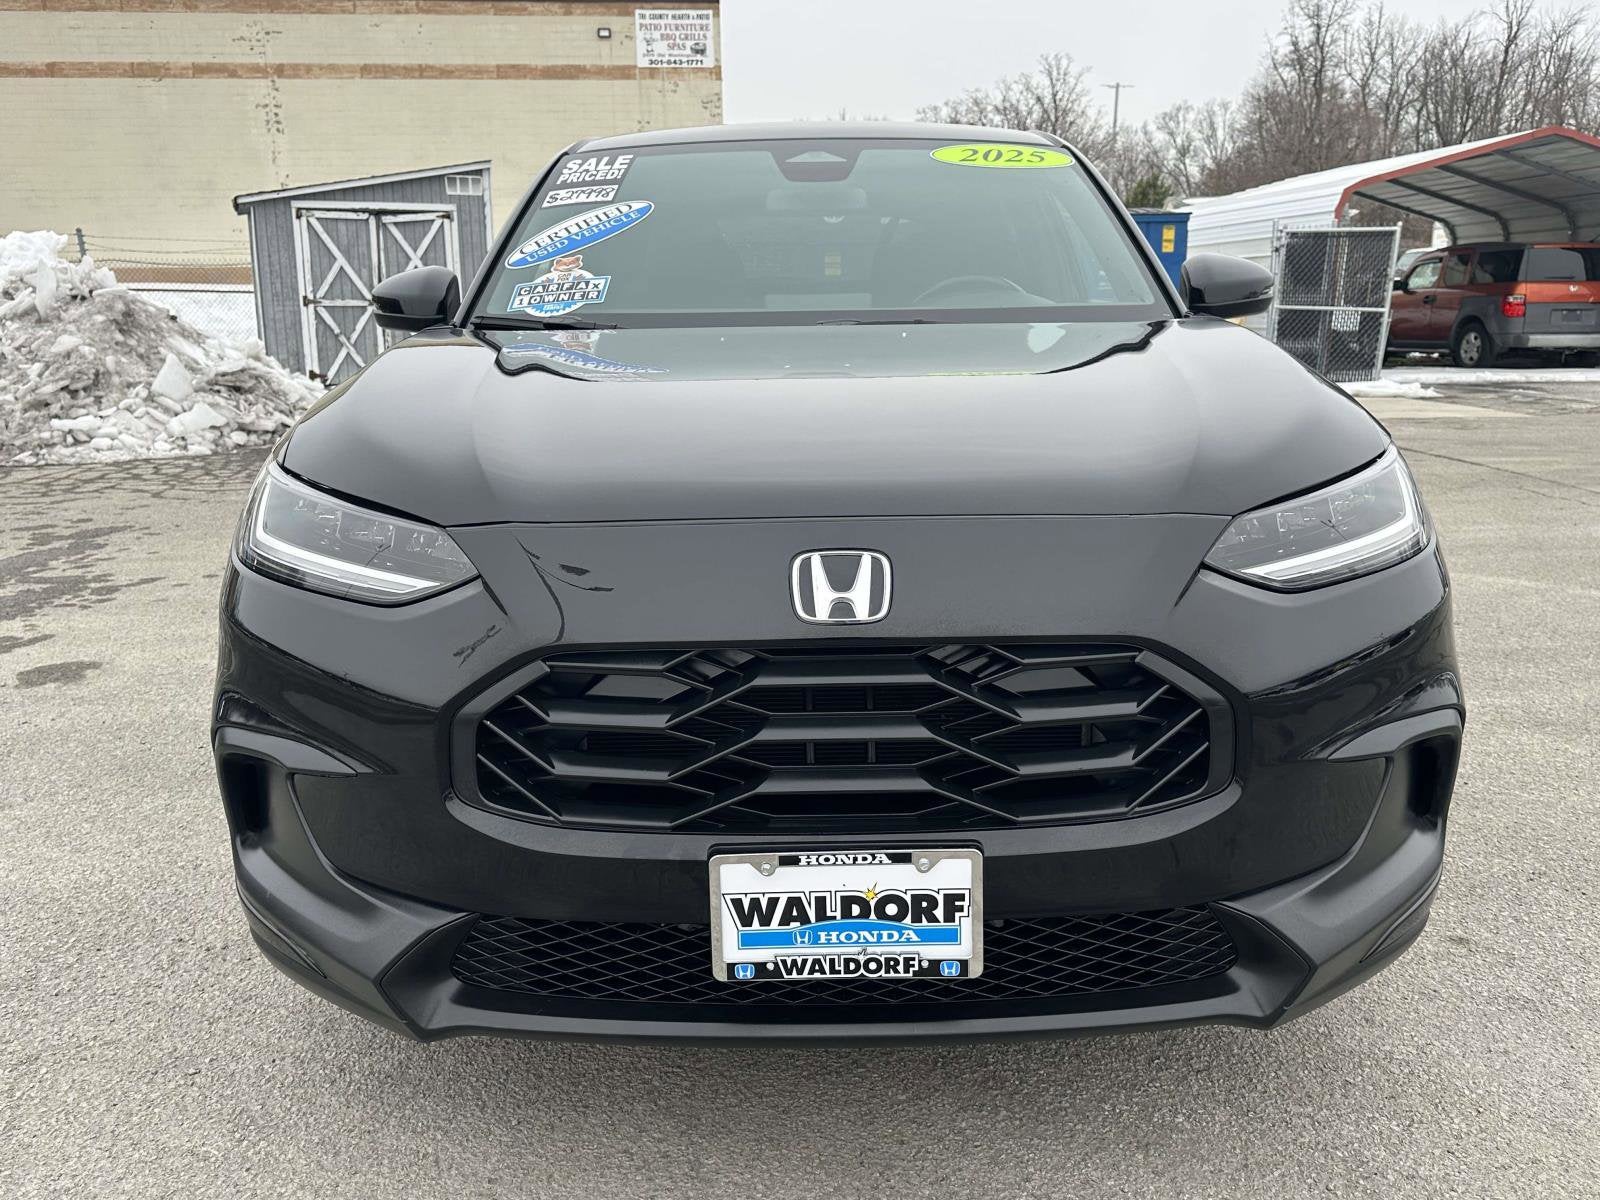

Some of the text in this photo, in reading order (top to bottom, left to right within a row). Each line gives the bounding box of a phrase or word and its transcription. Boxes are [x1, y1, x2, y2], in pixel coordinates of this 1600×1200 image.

[639, 23, 711, 31] PATIO FURNITURE
[660, 33, 708, 41] BBQ GRILLS
[959, 148, 1046, 163] 2025
[562, 154, 634, 174] SALE
[556, 168, 627, 185] PRICED!
[519, 203, 633, 256] CERTIFIED
[525, 210, 642, 262] USED VEHICLE
[519, 281, 601, 296] CARFAX
[530, 291, 599, 305] OWNER
[798, 853, 892, 866] HONDA
[729, 892, 967, 928] WALDORF
[818, 928, 921, 944] HONDA
[782, 954, 916, 977] WALDORF
